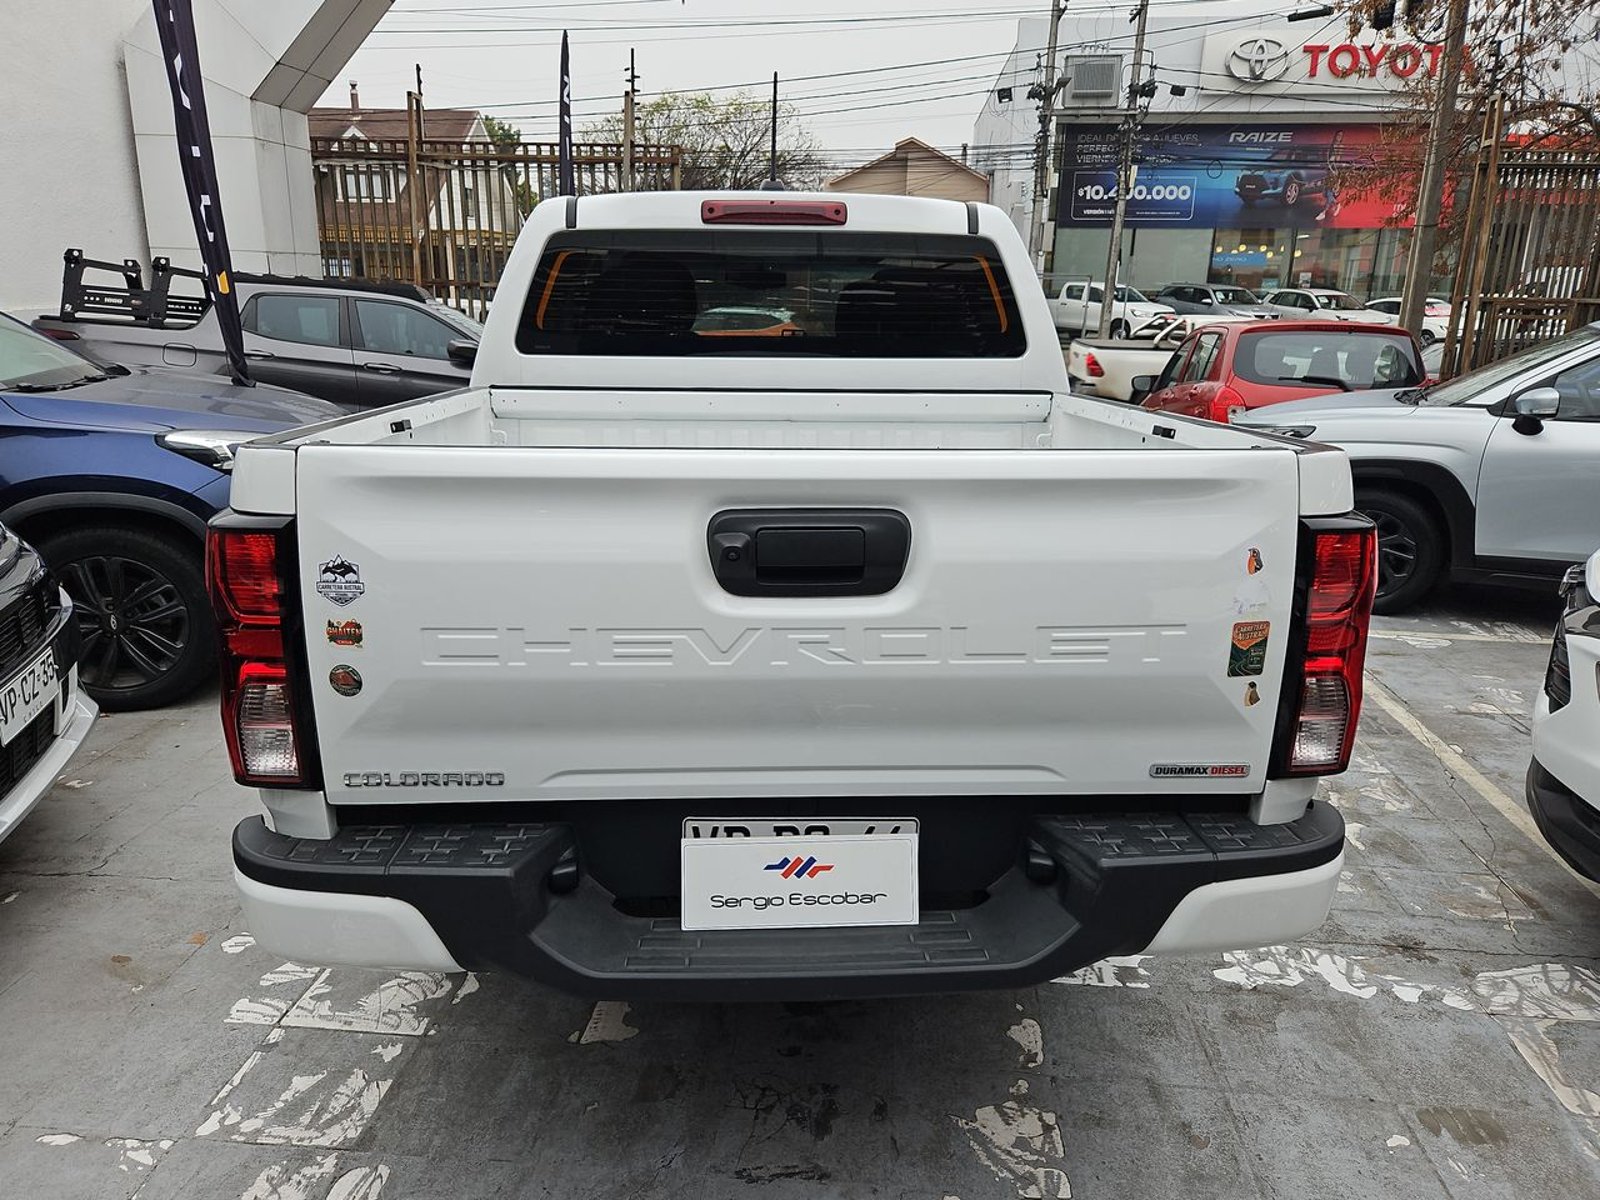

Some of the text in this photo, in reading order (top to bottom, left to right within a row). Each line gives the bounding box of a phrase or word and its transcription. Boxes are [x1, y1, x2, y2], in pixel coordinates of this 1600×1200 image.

[1229, 132, 1293, 143] RAIZE
[1076, 144, 1126, 153] PERFEC
[420, 624, 1187, 666] CHEVROLET
[1154, 766, 1247, 775] DURAMAX DIESEL
[343, 772, 505, 788] COLORADO
[710, 891, 888, 911] Sergio Escobar
